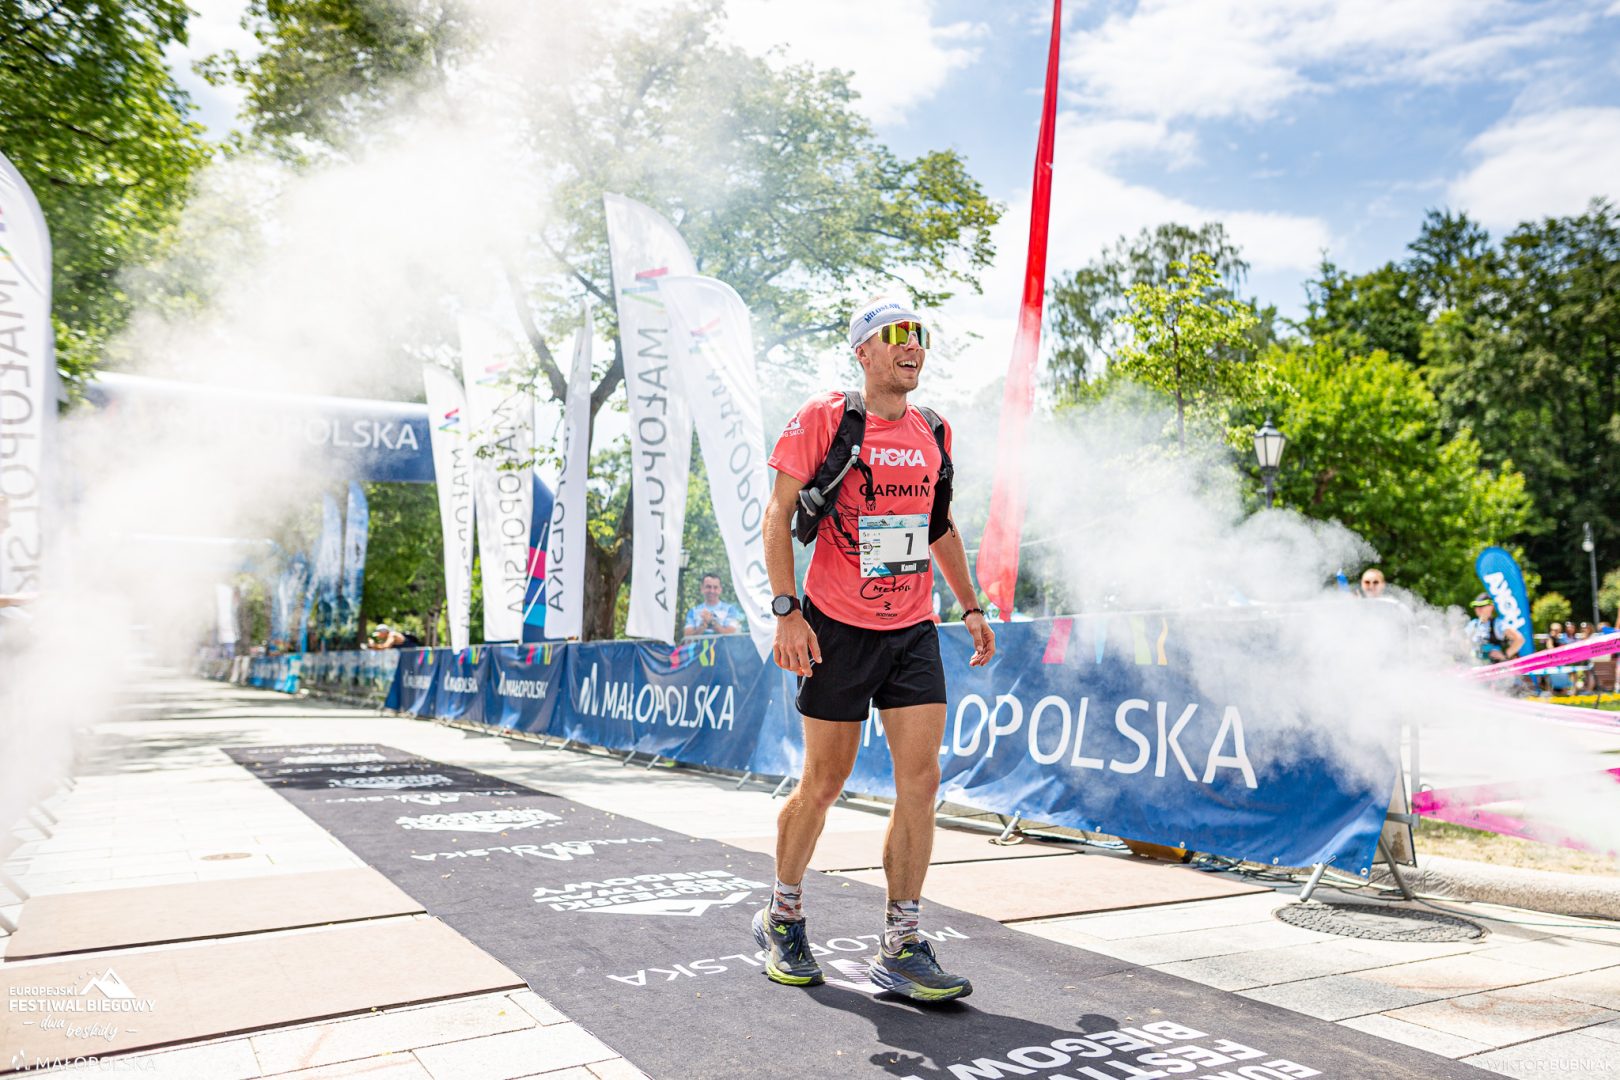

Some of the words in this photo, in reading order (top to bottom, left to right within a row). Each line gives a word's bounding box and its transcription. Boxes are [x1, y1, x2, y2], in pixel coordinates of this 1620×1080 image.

[869, 447, 926, 468] HOKA
[859, 484, 931, 497] GARMIN
[905, 533, 914, 555] 7
[601, 680, 735, 731] MAŁOPOLSKA
[864, 693, 1258, 789] MOPOLSKA
[606, 926, 970, 986] MOPLSKA
[901, 1020, 1210, 1080] BIEGOW
